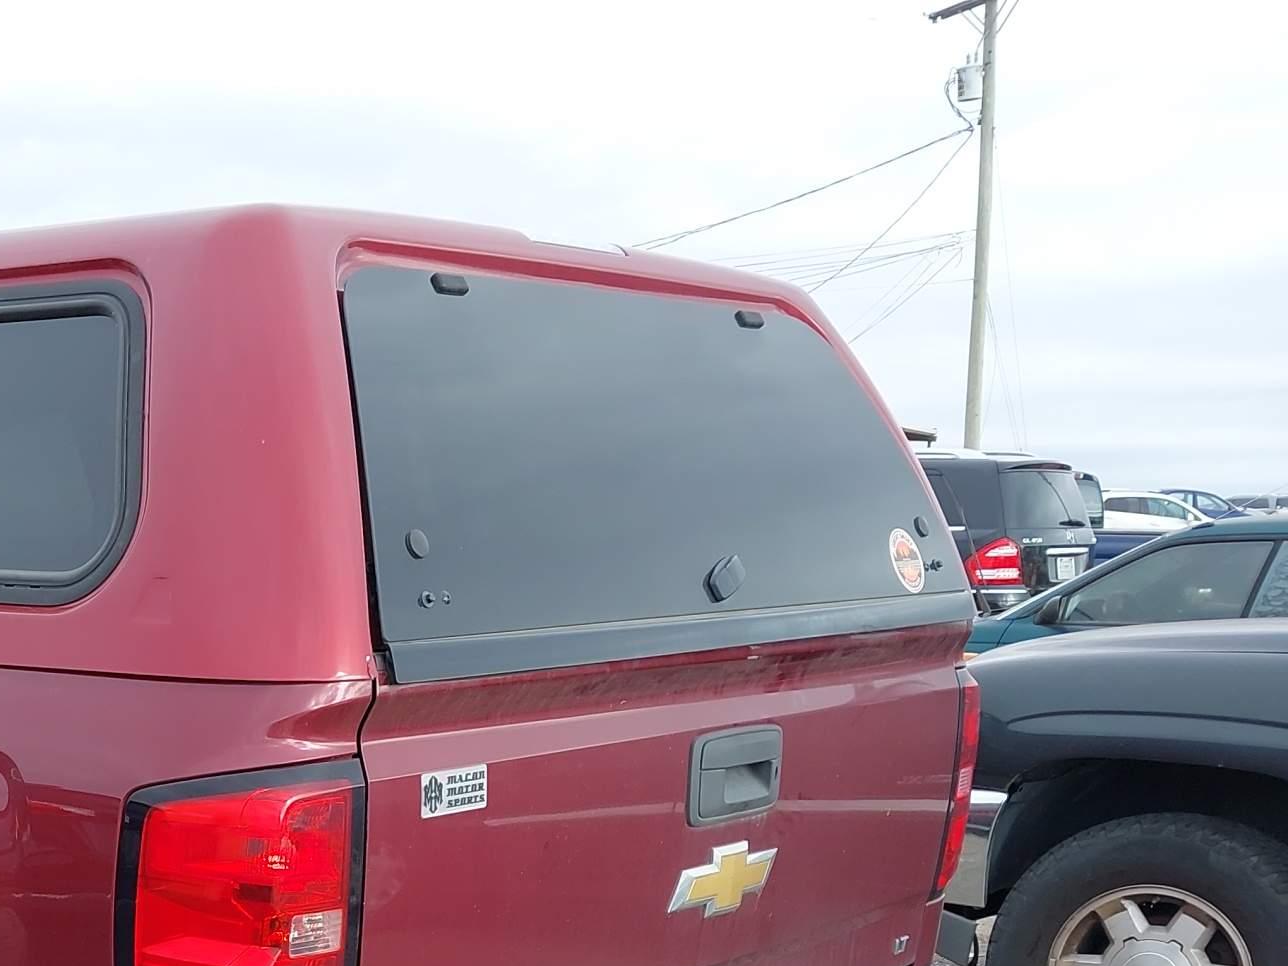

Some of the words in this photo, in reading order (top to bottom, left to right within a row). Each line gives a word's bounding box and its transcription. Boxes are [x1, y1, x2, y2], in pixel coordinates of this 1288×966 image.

[446, 770, 486, 785] MACON
[446, 782, 485, 797] MOTOR
[446, 794, 485, 808] SPORTS
[893, 934, 910, 955] LT
